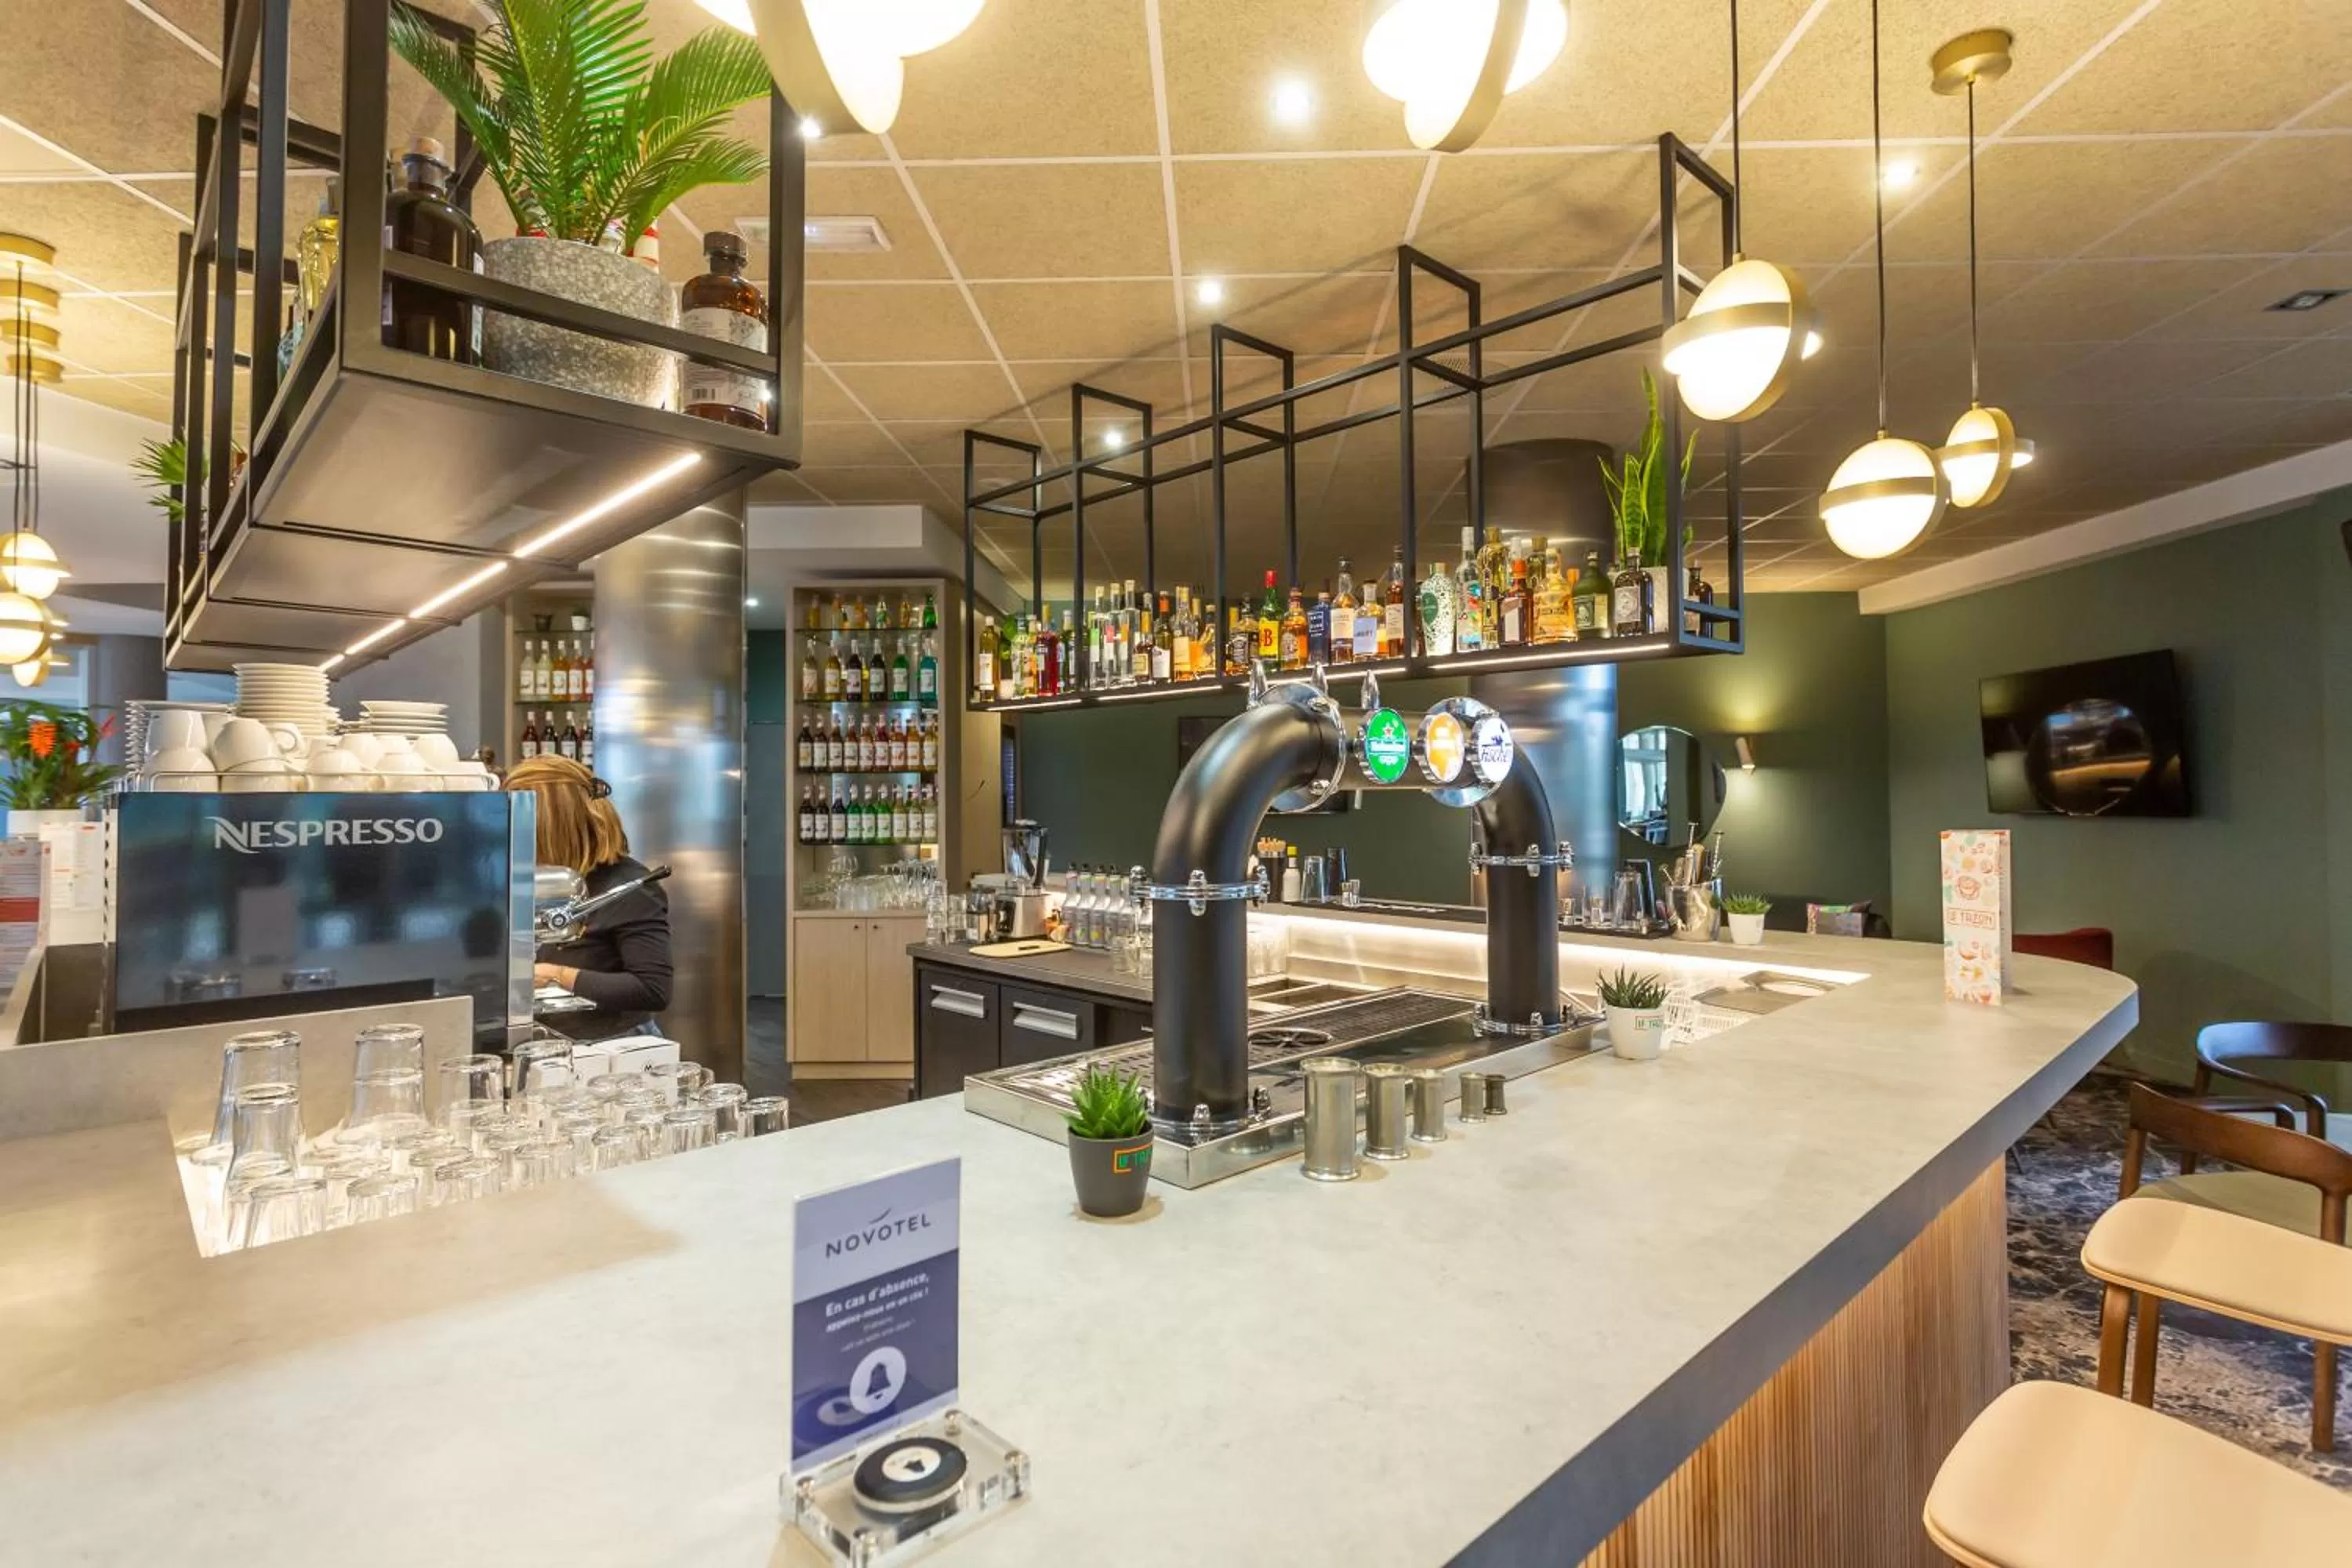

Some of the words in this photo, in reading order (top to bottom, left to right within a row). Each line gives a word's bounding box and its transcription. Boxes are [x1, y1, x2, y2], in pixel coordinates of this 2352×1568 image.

[204, 816, 444, 854] NESPRESSO
[826, 1214, 931, 1258] NOVOTEL
[826, 1302, 843, 1317] En
[844, 1294, 866, 1310] cas
